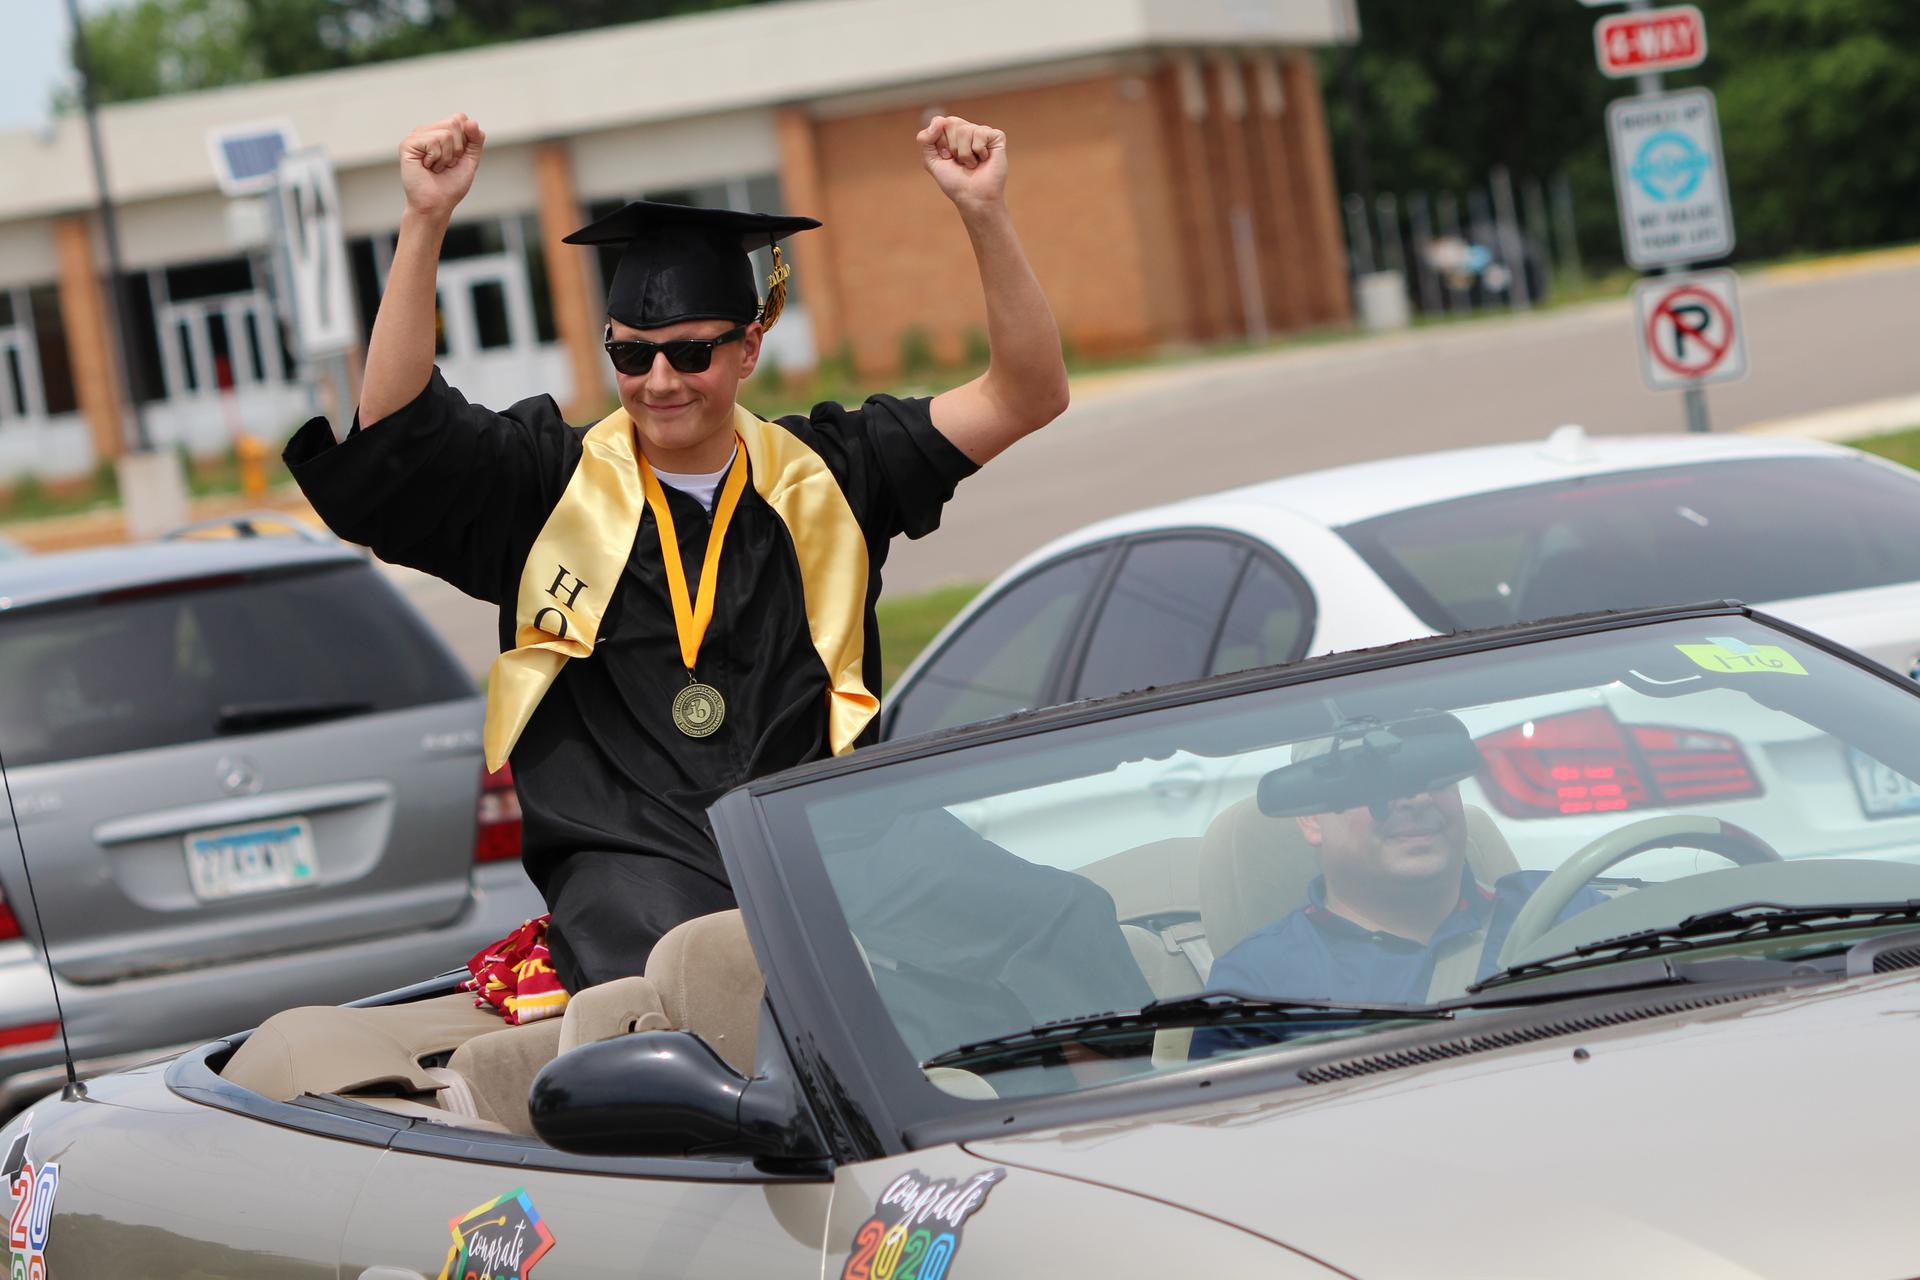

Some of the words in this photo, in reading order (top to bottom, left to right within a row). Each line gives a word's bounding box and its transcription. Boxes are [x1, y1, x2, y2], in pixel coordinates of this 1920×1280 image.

[1609, 19, 1694, 62] 4-WAY
[11, 1164, 57, 1250] 20
[844, 1219, 955, 1280] 2020
